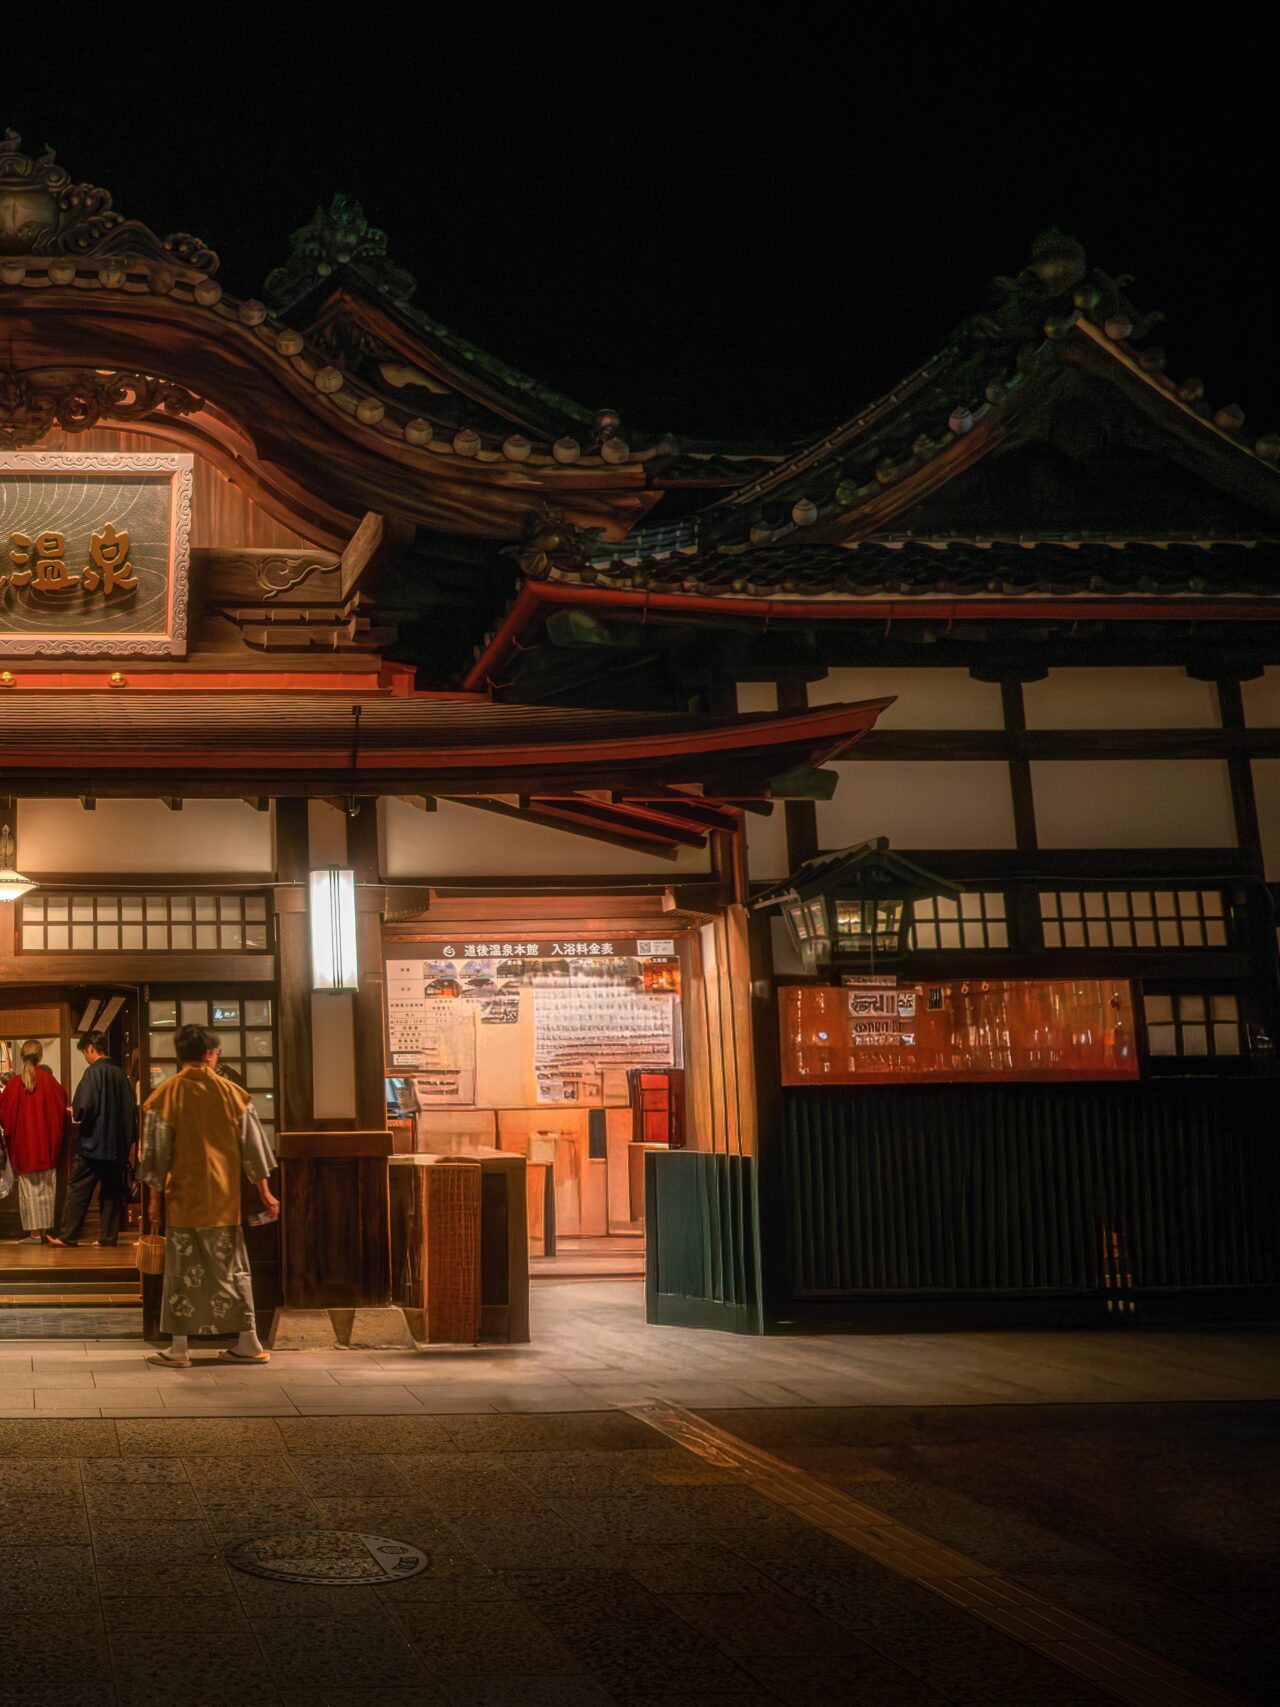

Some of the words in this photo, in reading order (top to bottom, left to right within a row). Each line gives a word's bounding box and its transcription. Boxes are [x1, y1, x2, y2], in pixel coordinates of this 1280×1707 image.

[464, 944, 539, 957] 道後温泉本館
[551, 943, 614, 956] 入浴料金表
